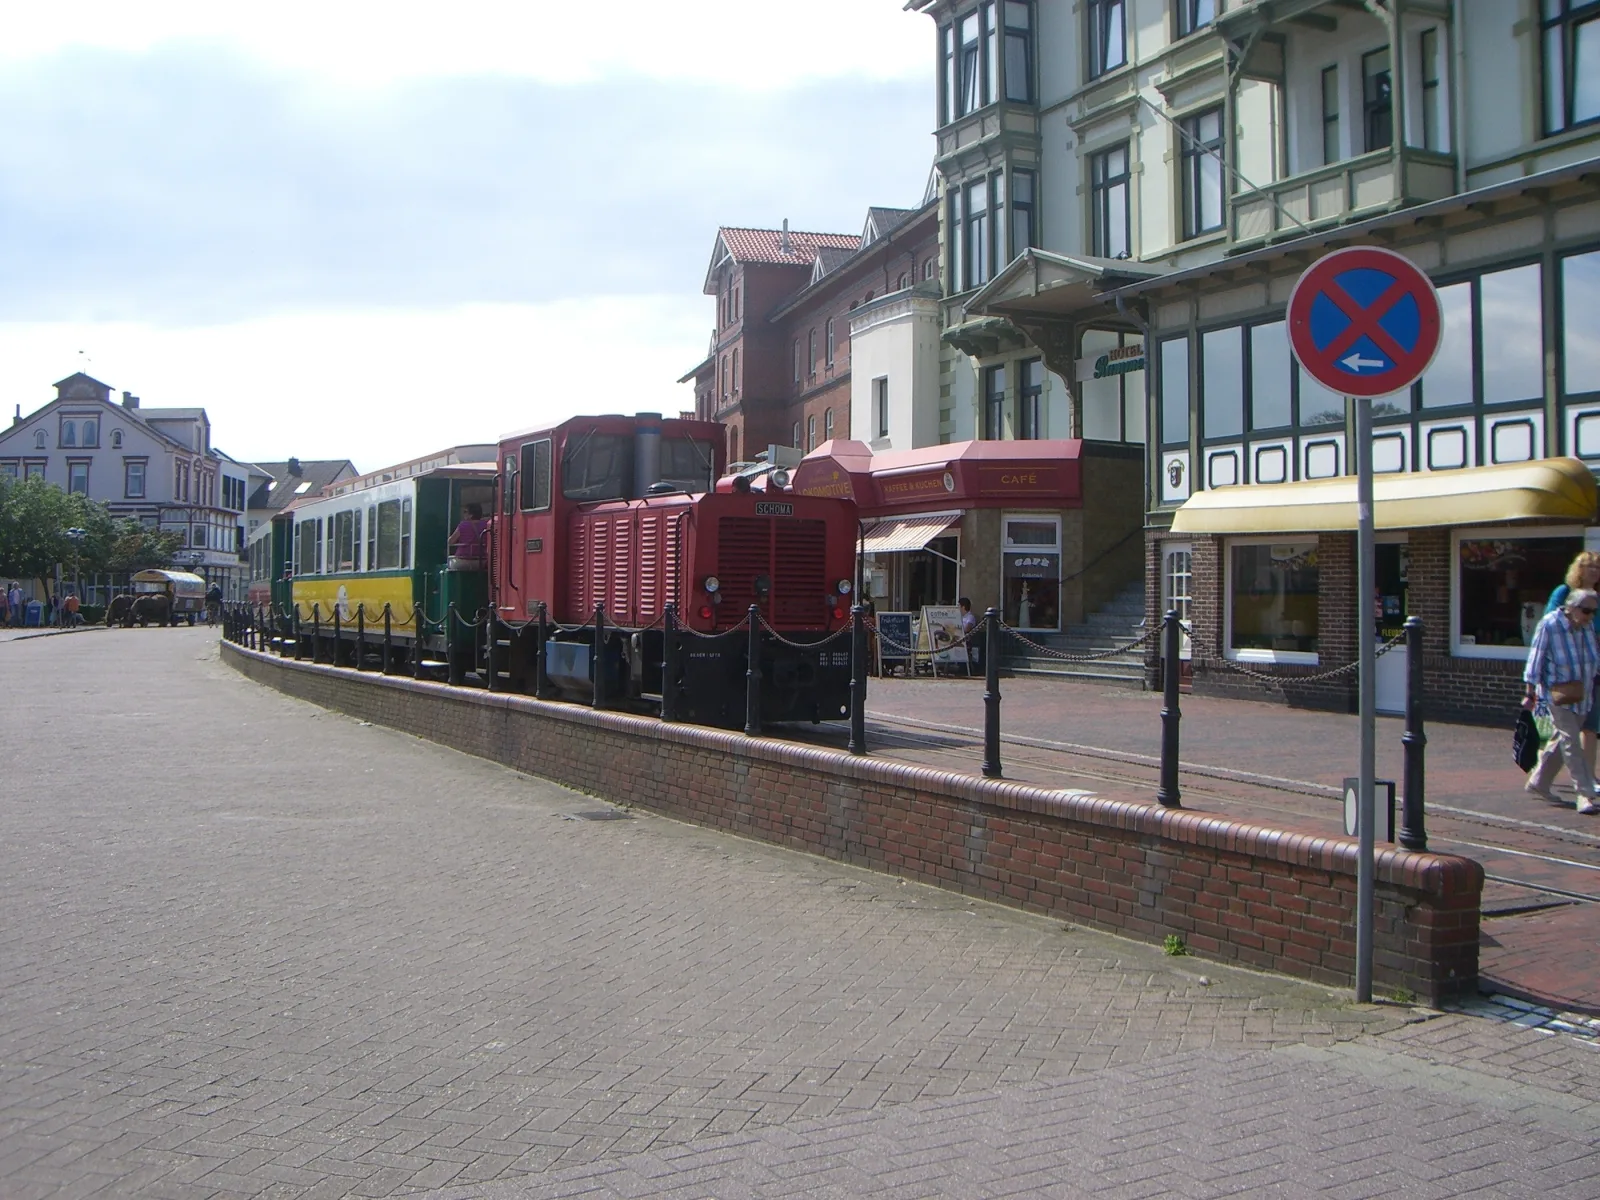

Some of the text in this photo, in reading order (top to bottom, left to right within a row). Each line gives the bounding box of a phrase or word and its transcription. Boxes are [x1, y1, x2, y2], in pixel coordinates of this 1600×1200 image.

[1109, 344, 1143, 361] HOTEL
[1001, 472, 1037, 484] CAFÉ
[884, 483, 909, 492] KAFFEE
[915, 479, 943, 489] KUCHEN
[1381, 629, 1403, 637] FLEUR
